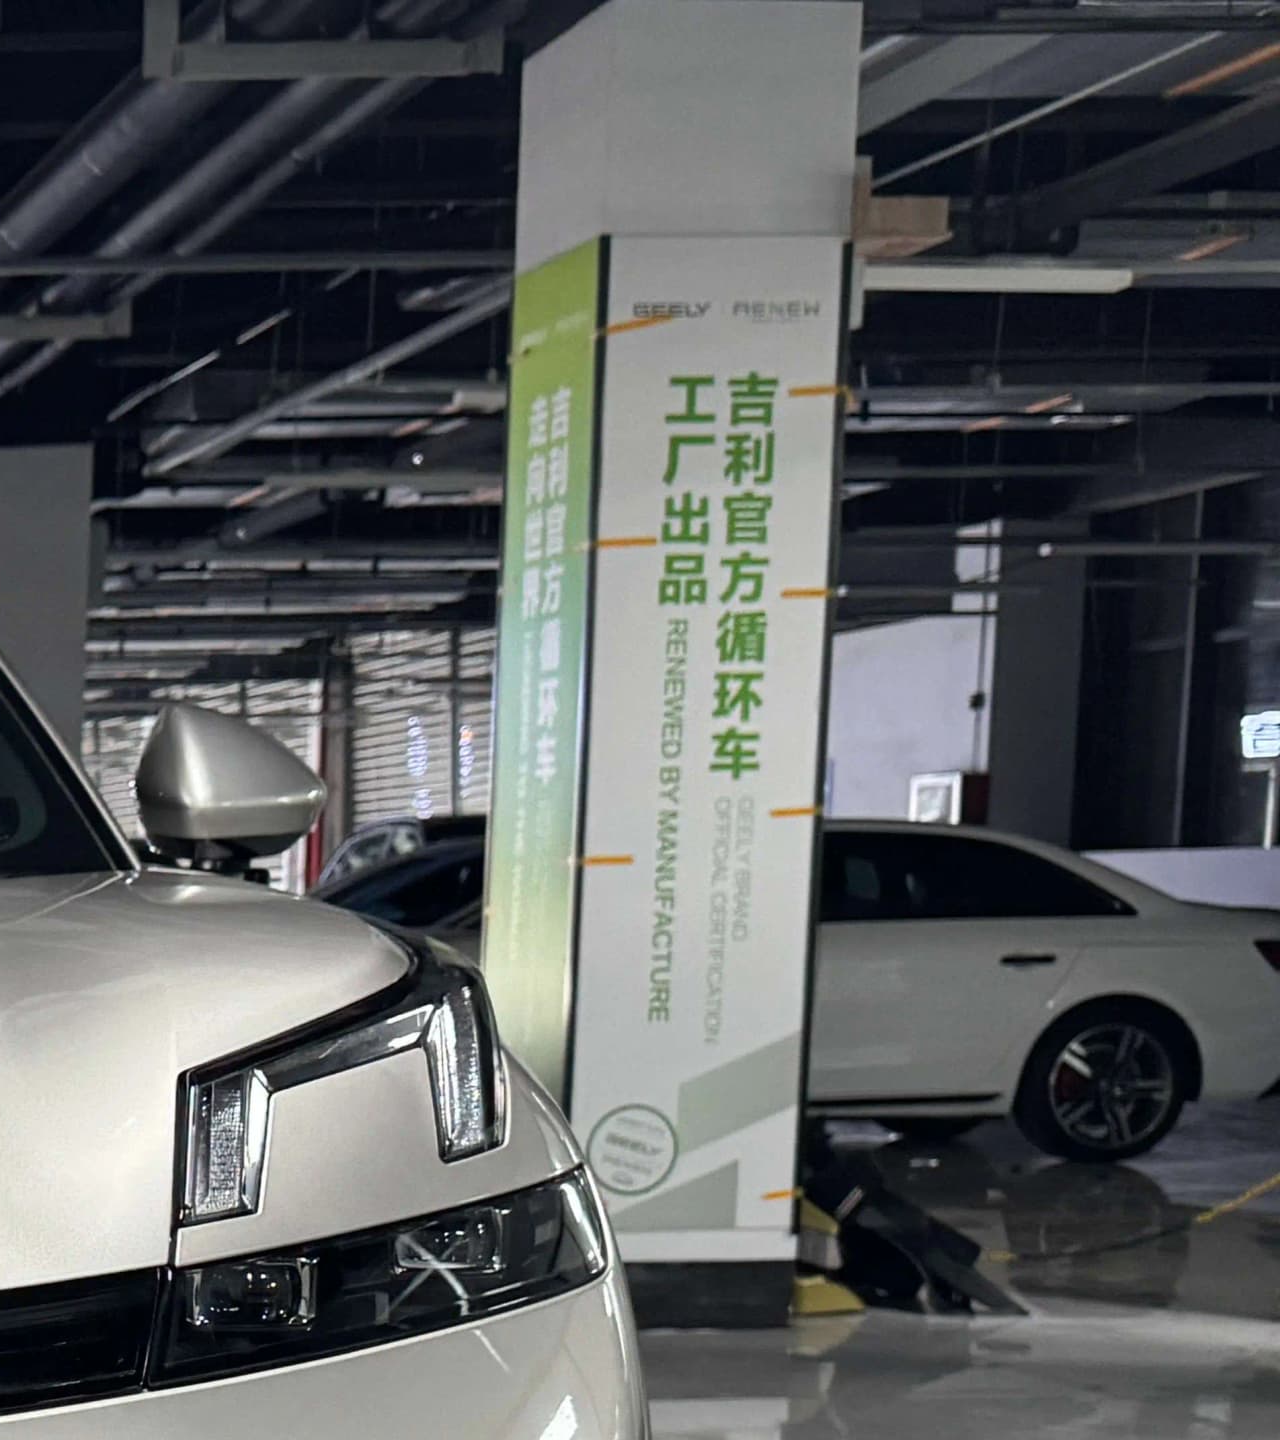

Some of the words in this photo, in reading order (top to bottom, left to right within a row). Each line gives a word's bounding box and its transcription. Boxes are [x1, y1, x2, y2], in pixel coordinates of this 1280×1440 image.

[633, 302, 711, 318] GEELY
[657, 375, 715, 606] 工厂出品
[709, 371, 779, 780] 吉利官方循环车
[660, 618, 689, 760] RENEWED
[658, 766, 681, 805] BY
[648, 809, 678, 1023] MANUFACTURE
